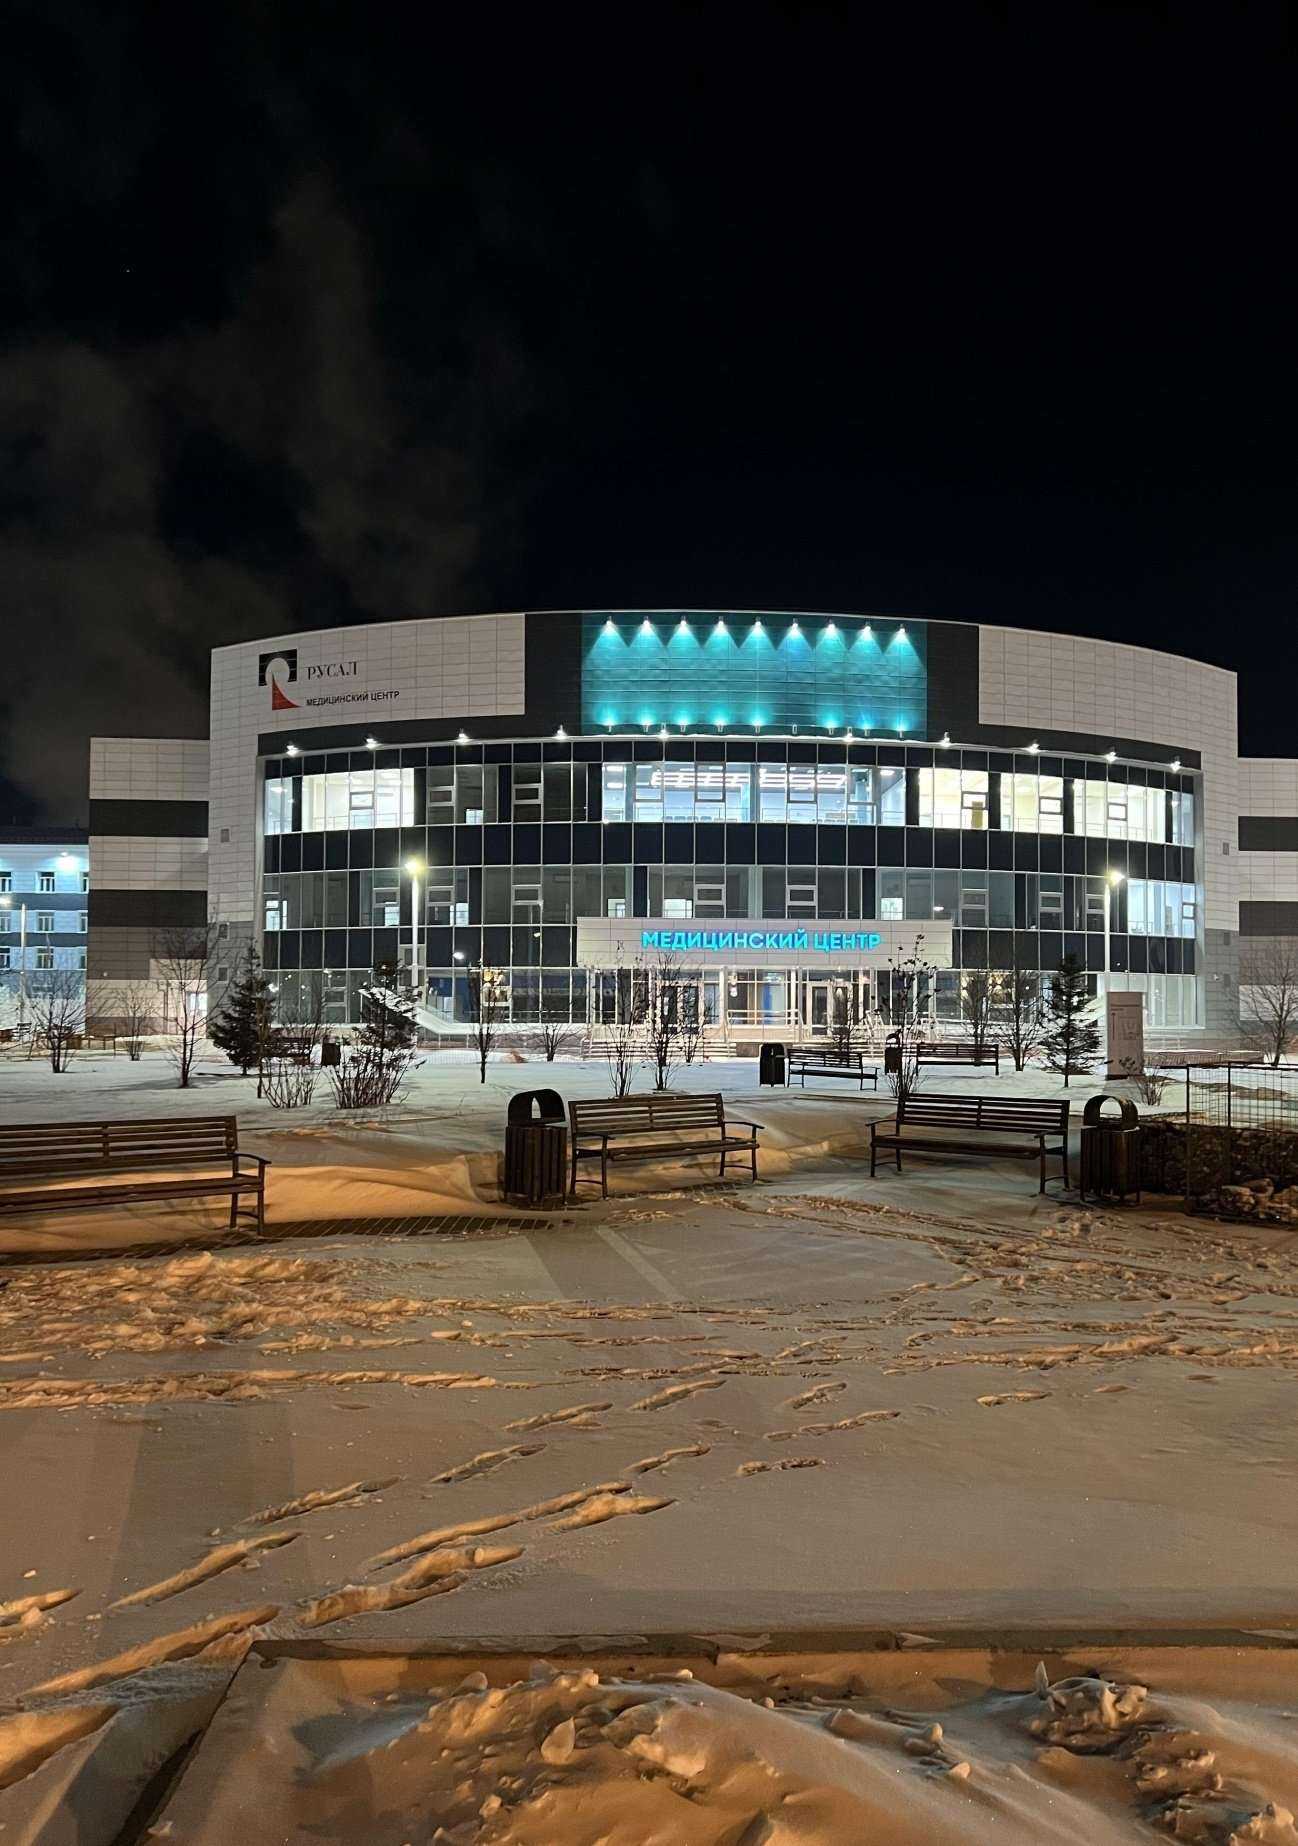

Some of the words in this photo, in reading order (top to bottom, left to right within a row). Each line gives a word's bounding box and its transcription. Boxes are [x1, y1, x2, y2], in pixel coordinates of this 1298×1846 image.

[306, 661, 358, 680] РУСАЛ
[306, 692, 368, 706] МЕДИЦИНСКИЙ
[371, 691, 400, 701] ЦЕНТР
[641, 929, 808, 951] МЕДИЦИНСКИЙ
[814, 933, 881, 952] ЦЕНТР
